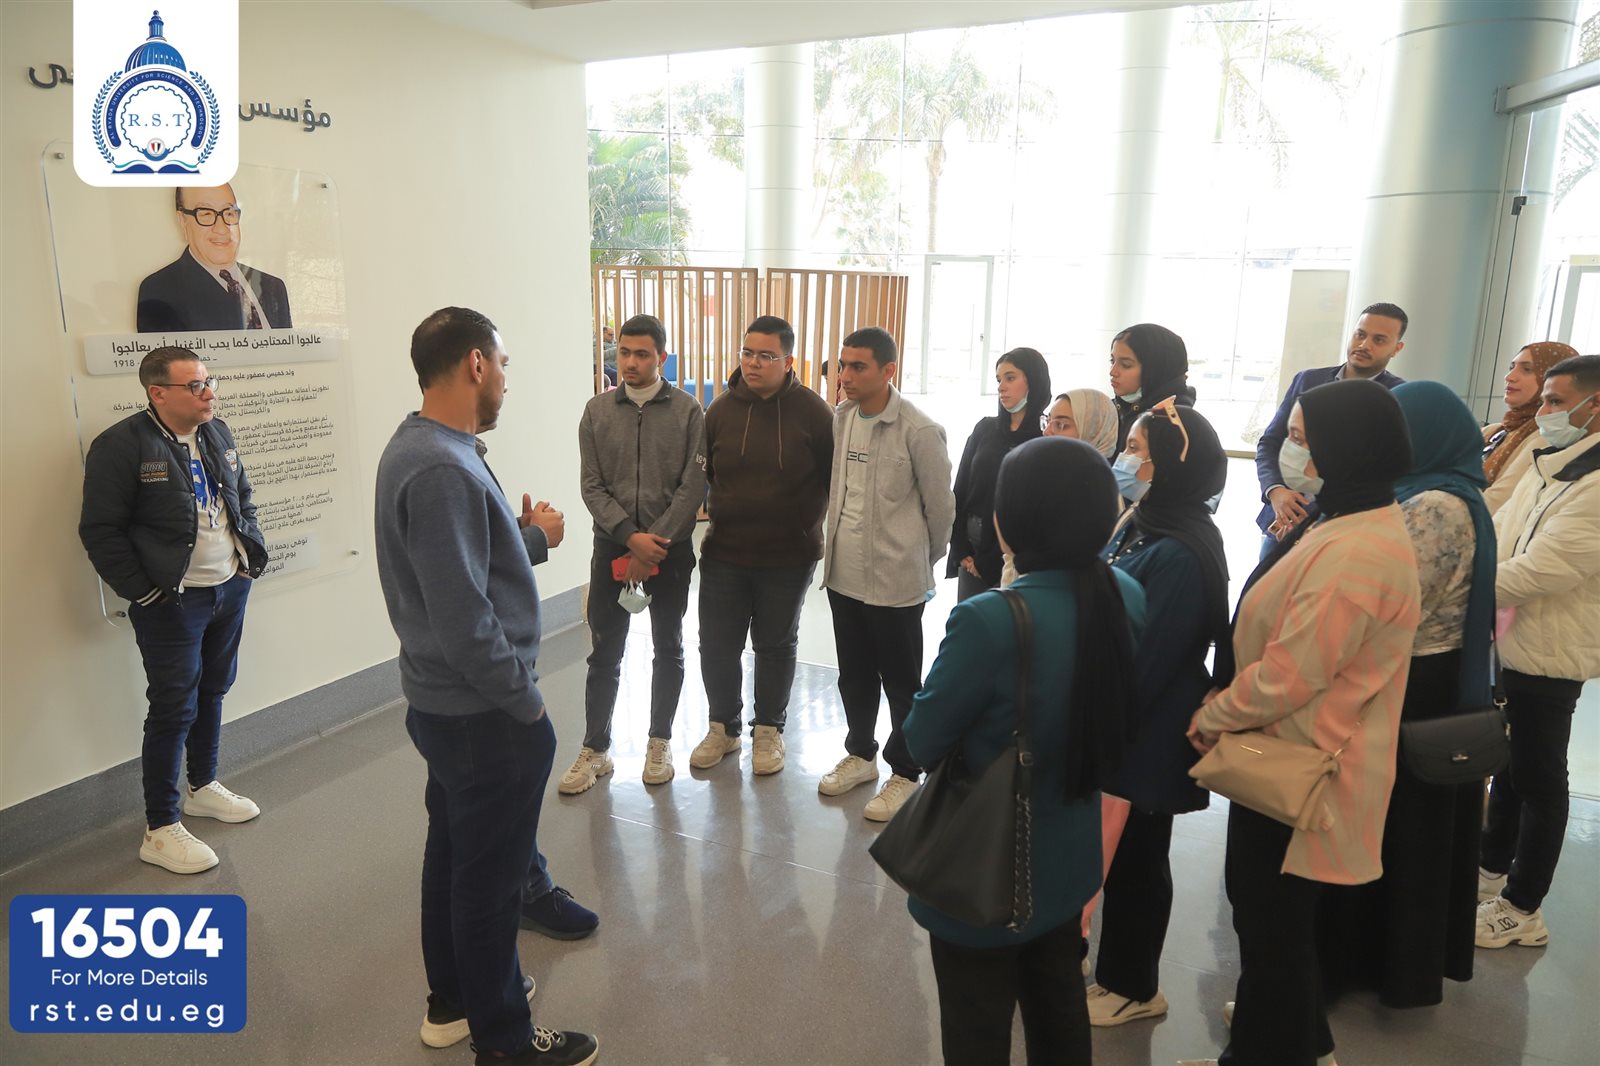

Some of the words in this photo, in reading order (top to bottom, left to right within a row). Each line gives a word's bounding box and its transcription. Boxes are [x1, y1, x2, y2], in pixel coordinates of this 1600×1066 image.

[209, 339, 230, 350] يحب
[232, 337, 248, 348] كما
[252, 335, 294, 349] المحتاجين
[297, 334, 321, 347] عالجوا
[114, 360, 134, 368] 1918
